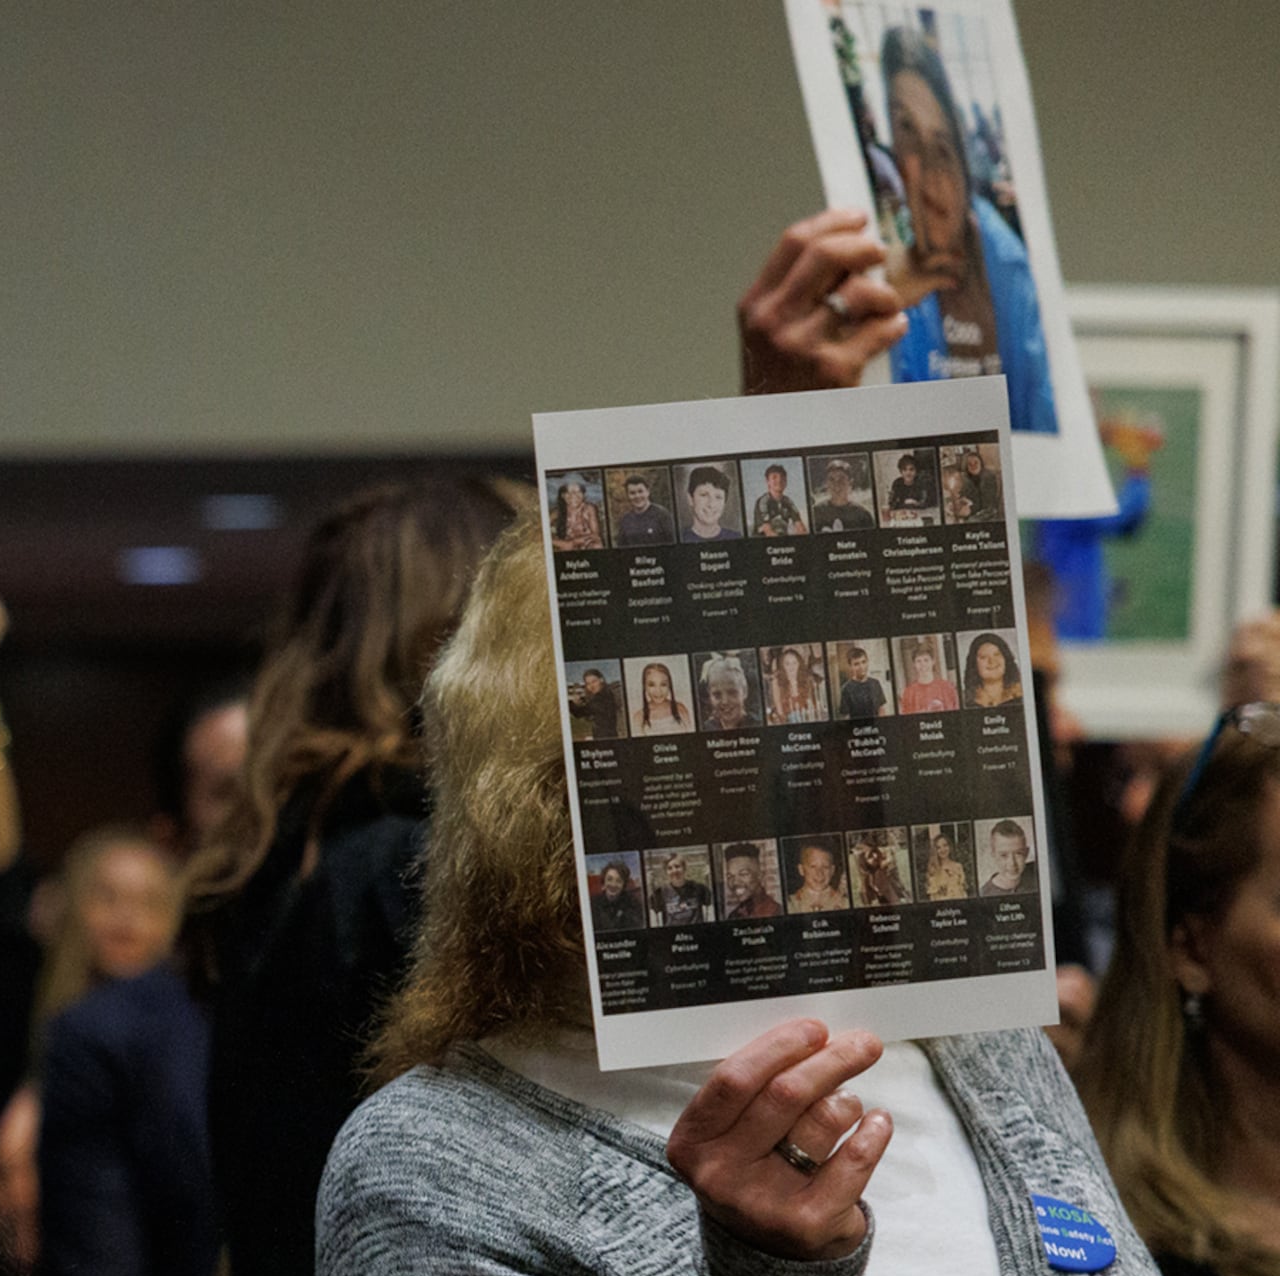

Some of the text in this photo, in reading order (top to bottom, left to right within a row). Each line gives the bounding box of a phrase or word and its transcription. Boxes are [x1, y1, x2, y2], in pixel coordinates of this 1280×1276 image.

[837, 541, 856, 549] Nate
[767, 546, 795, 555] Carson
[700, 552, 728, 560] Mason
[771, 556, 792, 565] Bride
[829, 551, 867, 562] Bronstein
[635, 557, 656, 566] Riley
[700, 561, 730, 572] Bogard
[560, 571, 599, 580] Anderson
[984, 716, 1005, 725] Emily
[920, 721, 942, 731] David
[788, 731, 812, 742] Grace
[707, 737, 760, 749] Mallory Rose
[653, 744, 678, 753] Olivia
[654, 755, 679, 764] Green
[803, 929, 840, 940] Robinson
[1048, 1206, 1094, 1225] KOSA
[1044, 1241, 1087, 1261] Now!
